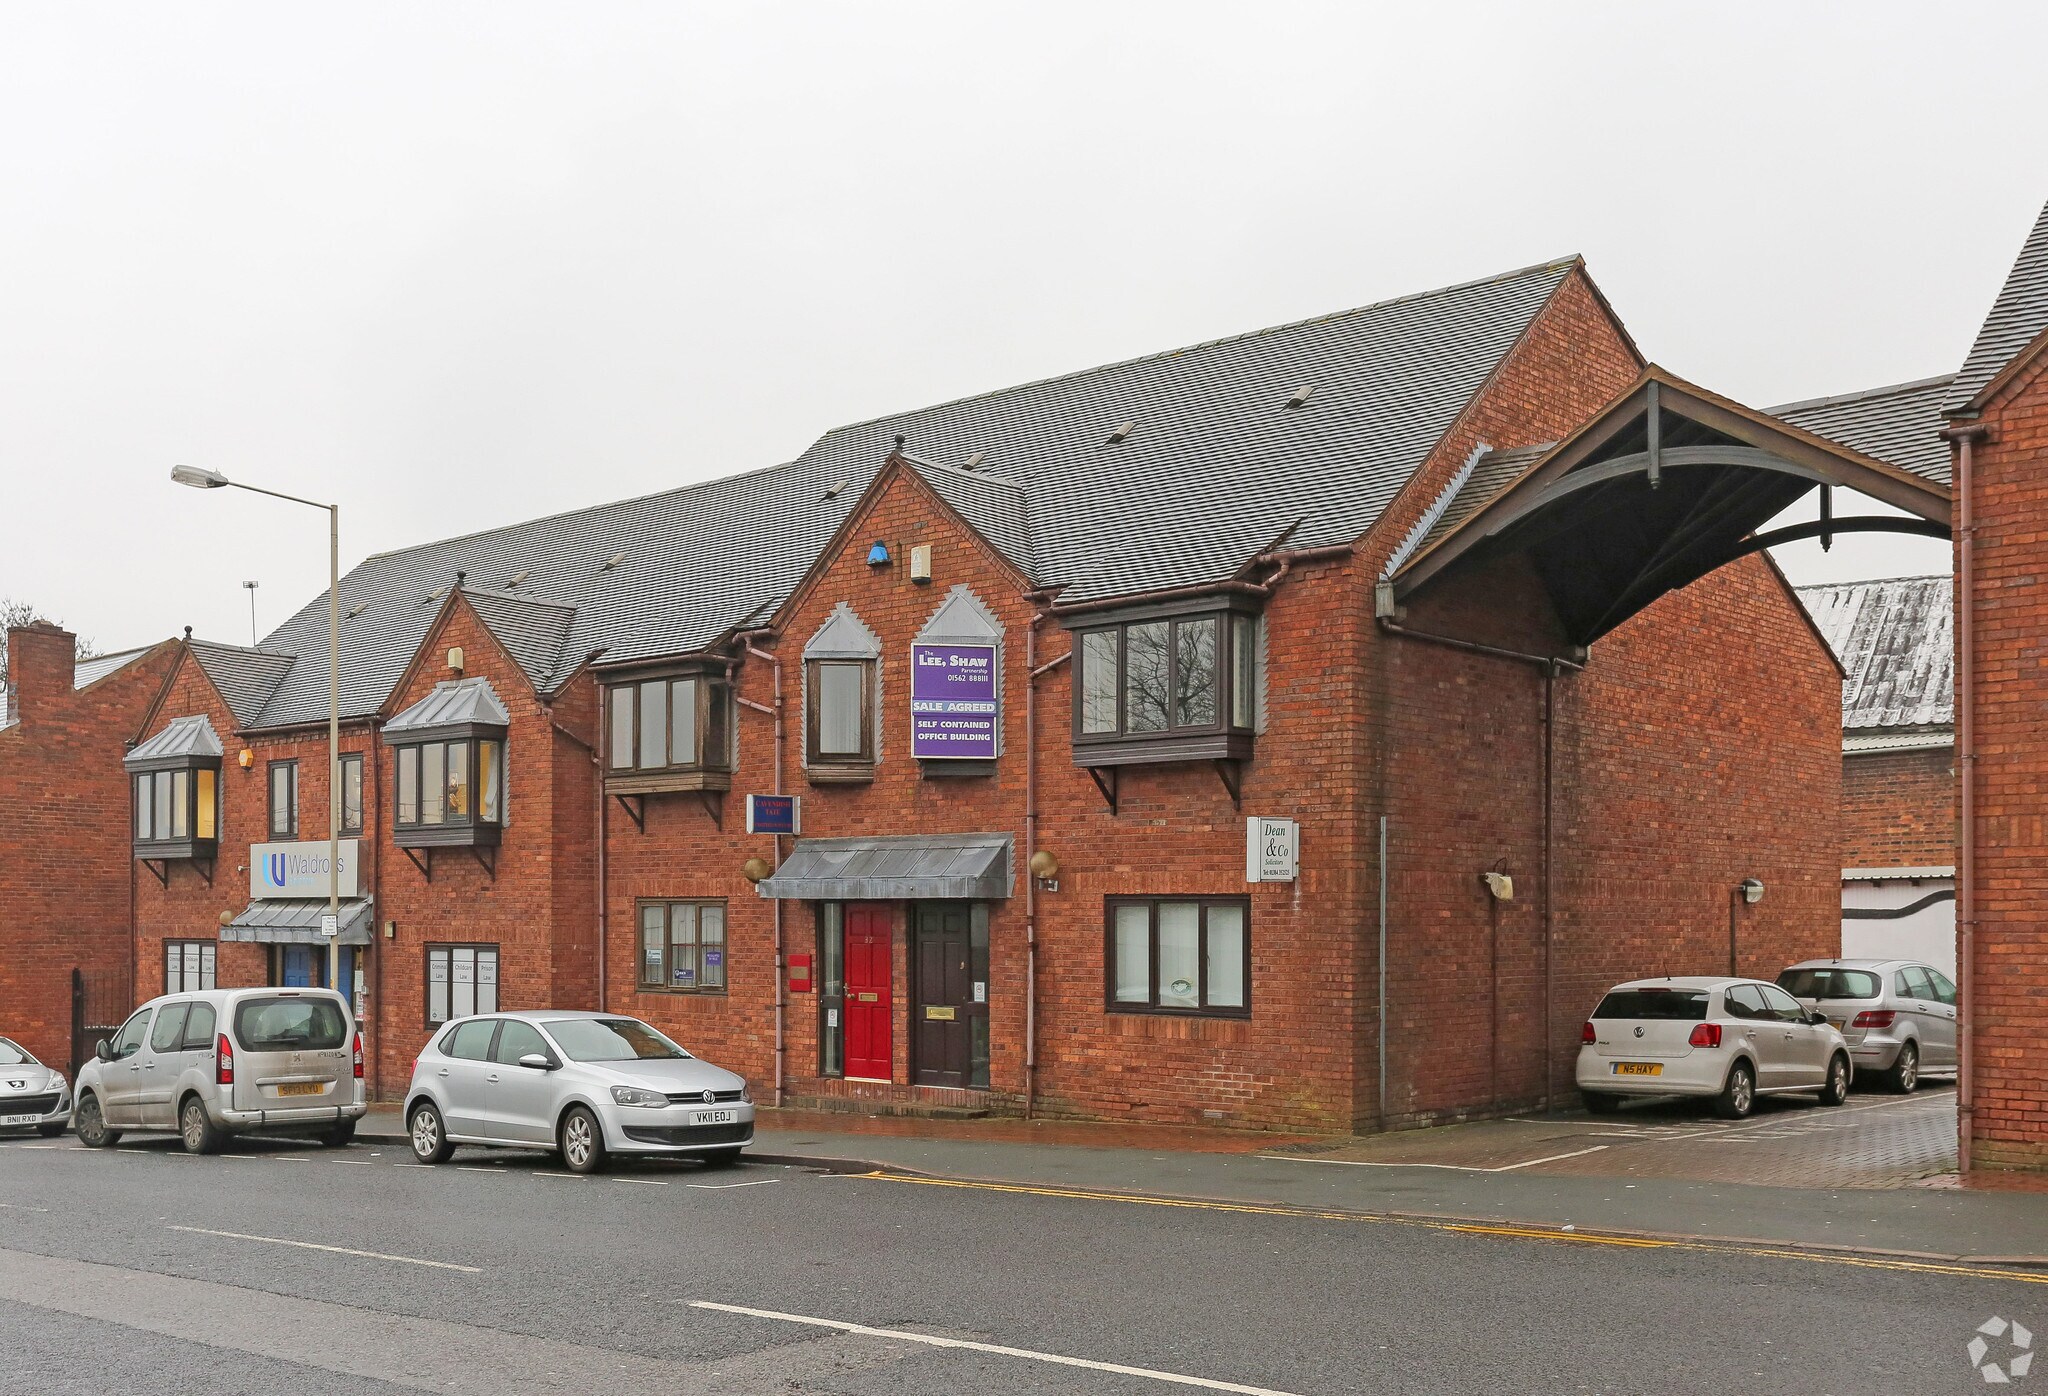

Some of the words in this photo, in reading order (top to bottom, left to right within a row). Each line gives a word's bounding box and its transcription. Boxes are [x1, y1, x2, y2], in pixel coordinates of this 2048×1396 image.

[950, 655, 988, 667] SHAW
[947, 674, 966, 682] 01562
[913, 702, 943, 711] SALE
[946, 703, 995, 712] AGREED
[940, 721, 990, 729] CONTAINED
[1265, 824, 1286, 836] Dean
[289, 854, 344, 875] Waldros
[1623, 1065, 1634, 1073] N5
[1636, 1065, 1654, 1074] HAY
[697, 1112, 713, 1122] VK11
[714, 1111, 730, 1122] EOJ
